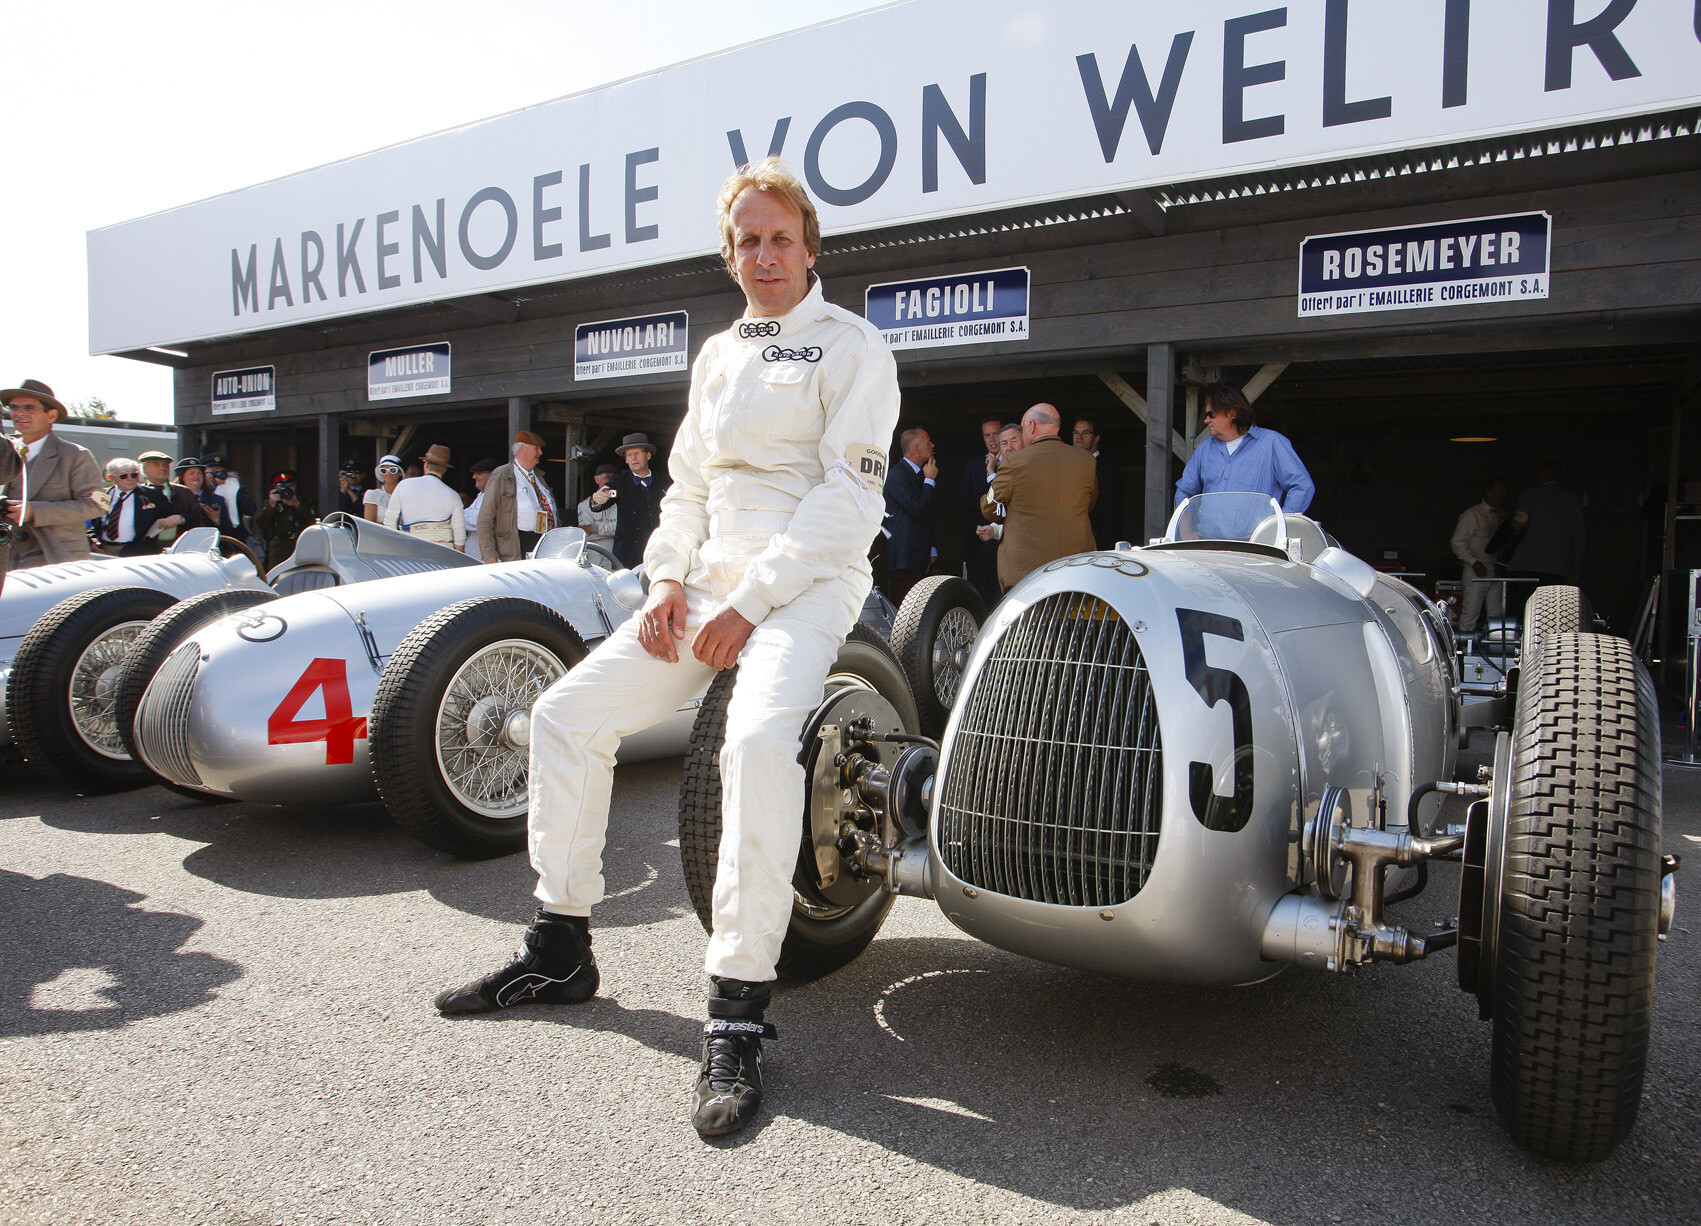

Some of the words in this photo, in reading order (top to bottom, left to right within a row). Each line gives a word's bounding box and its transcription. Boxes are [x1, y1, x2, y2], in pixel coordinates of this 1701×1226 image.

[231, 146, 660, 317] MARKENOELE
[1076, 0, 1701, 164] WELR
[1322, 231, 1521, 281] ROSEMEYER
[895, 280, 995, 321] FAGIOLI
[1301, 296, 1334, 312] Offert
[1336, 294, 1357, 310] par
[1369, 287, 1434, 306] EMAILLERIE
[1440, 280, 1513, 301] CORGEMONT
[1520, 278, 1544, 295] S.A.
[587, 321, 675, 355] NUVOLARI
[889, 332, 904, 345] par
[911, 326, 955, 342] EMAILLERIE
[958, 321, 1006, 338] CORGEMONT
[1010, 320, 1026, 333] S.A.
[385, 352, 434, 377] MULLER
[216, 372, 270, 396] AUTO-UNION
[267, 657, 368, 765] 4
[1174, 607, 1255, 833] 5
[703, 1019, 764, 1034] alpinestars
